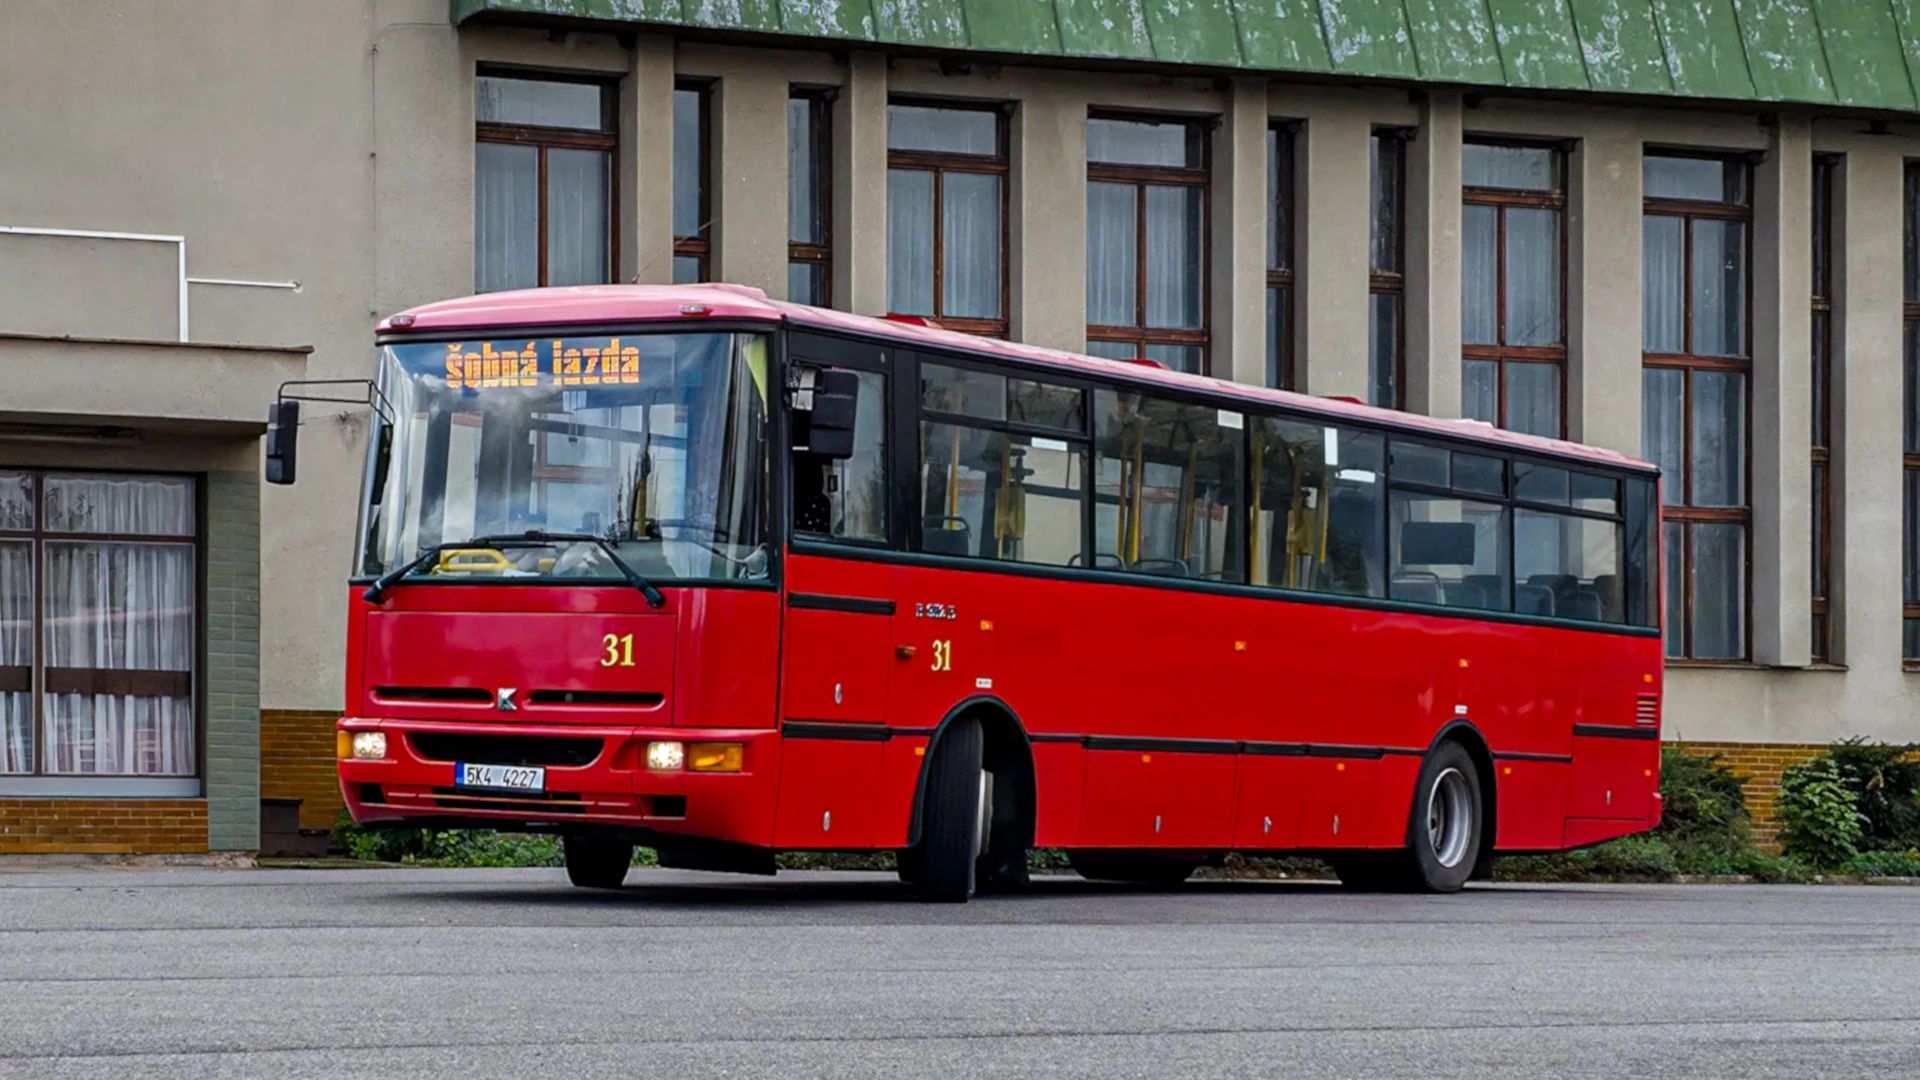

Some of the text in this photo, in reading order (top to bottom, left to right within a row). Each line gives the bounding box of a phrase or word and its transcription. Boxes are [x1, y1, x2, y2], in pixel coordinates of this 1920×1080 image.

[601, 633, 636, 667] 31
[931, 639, 951, 671] 31
[467, 766, 538, 789] 5K4 4227
